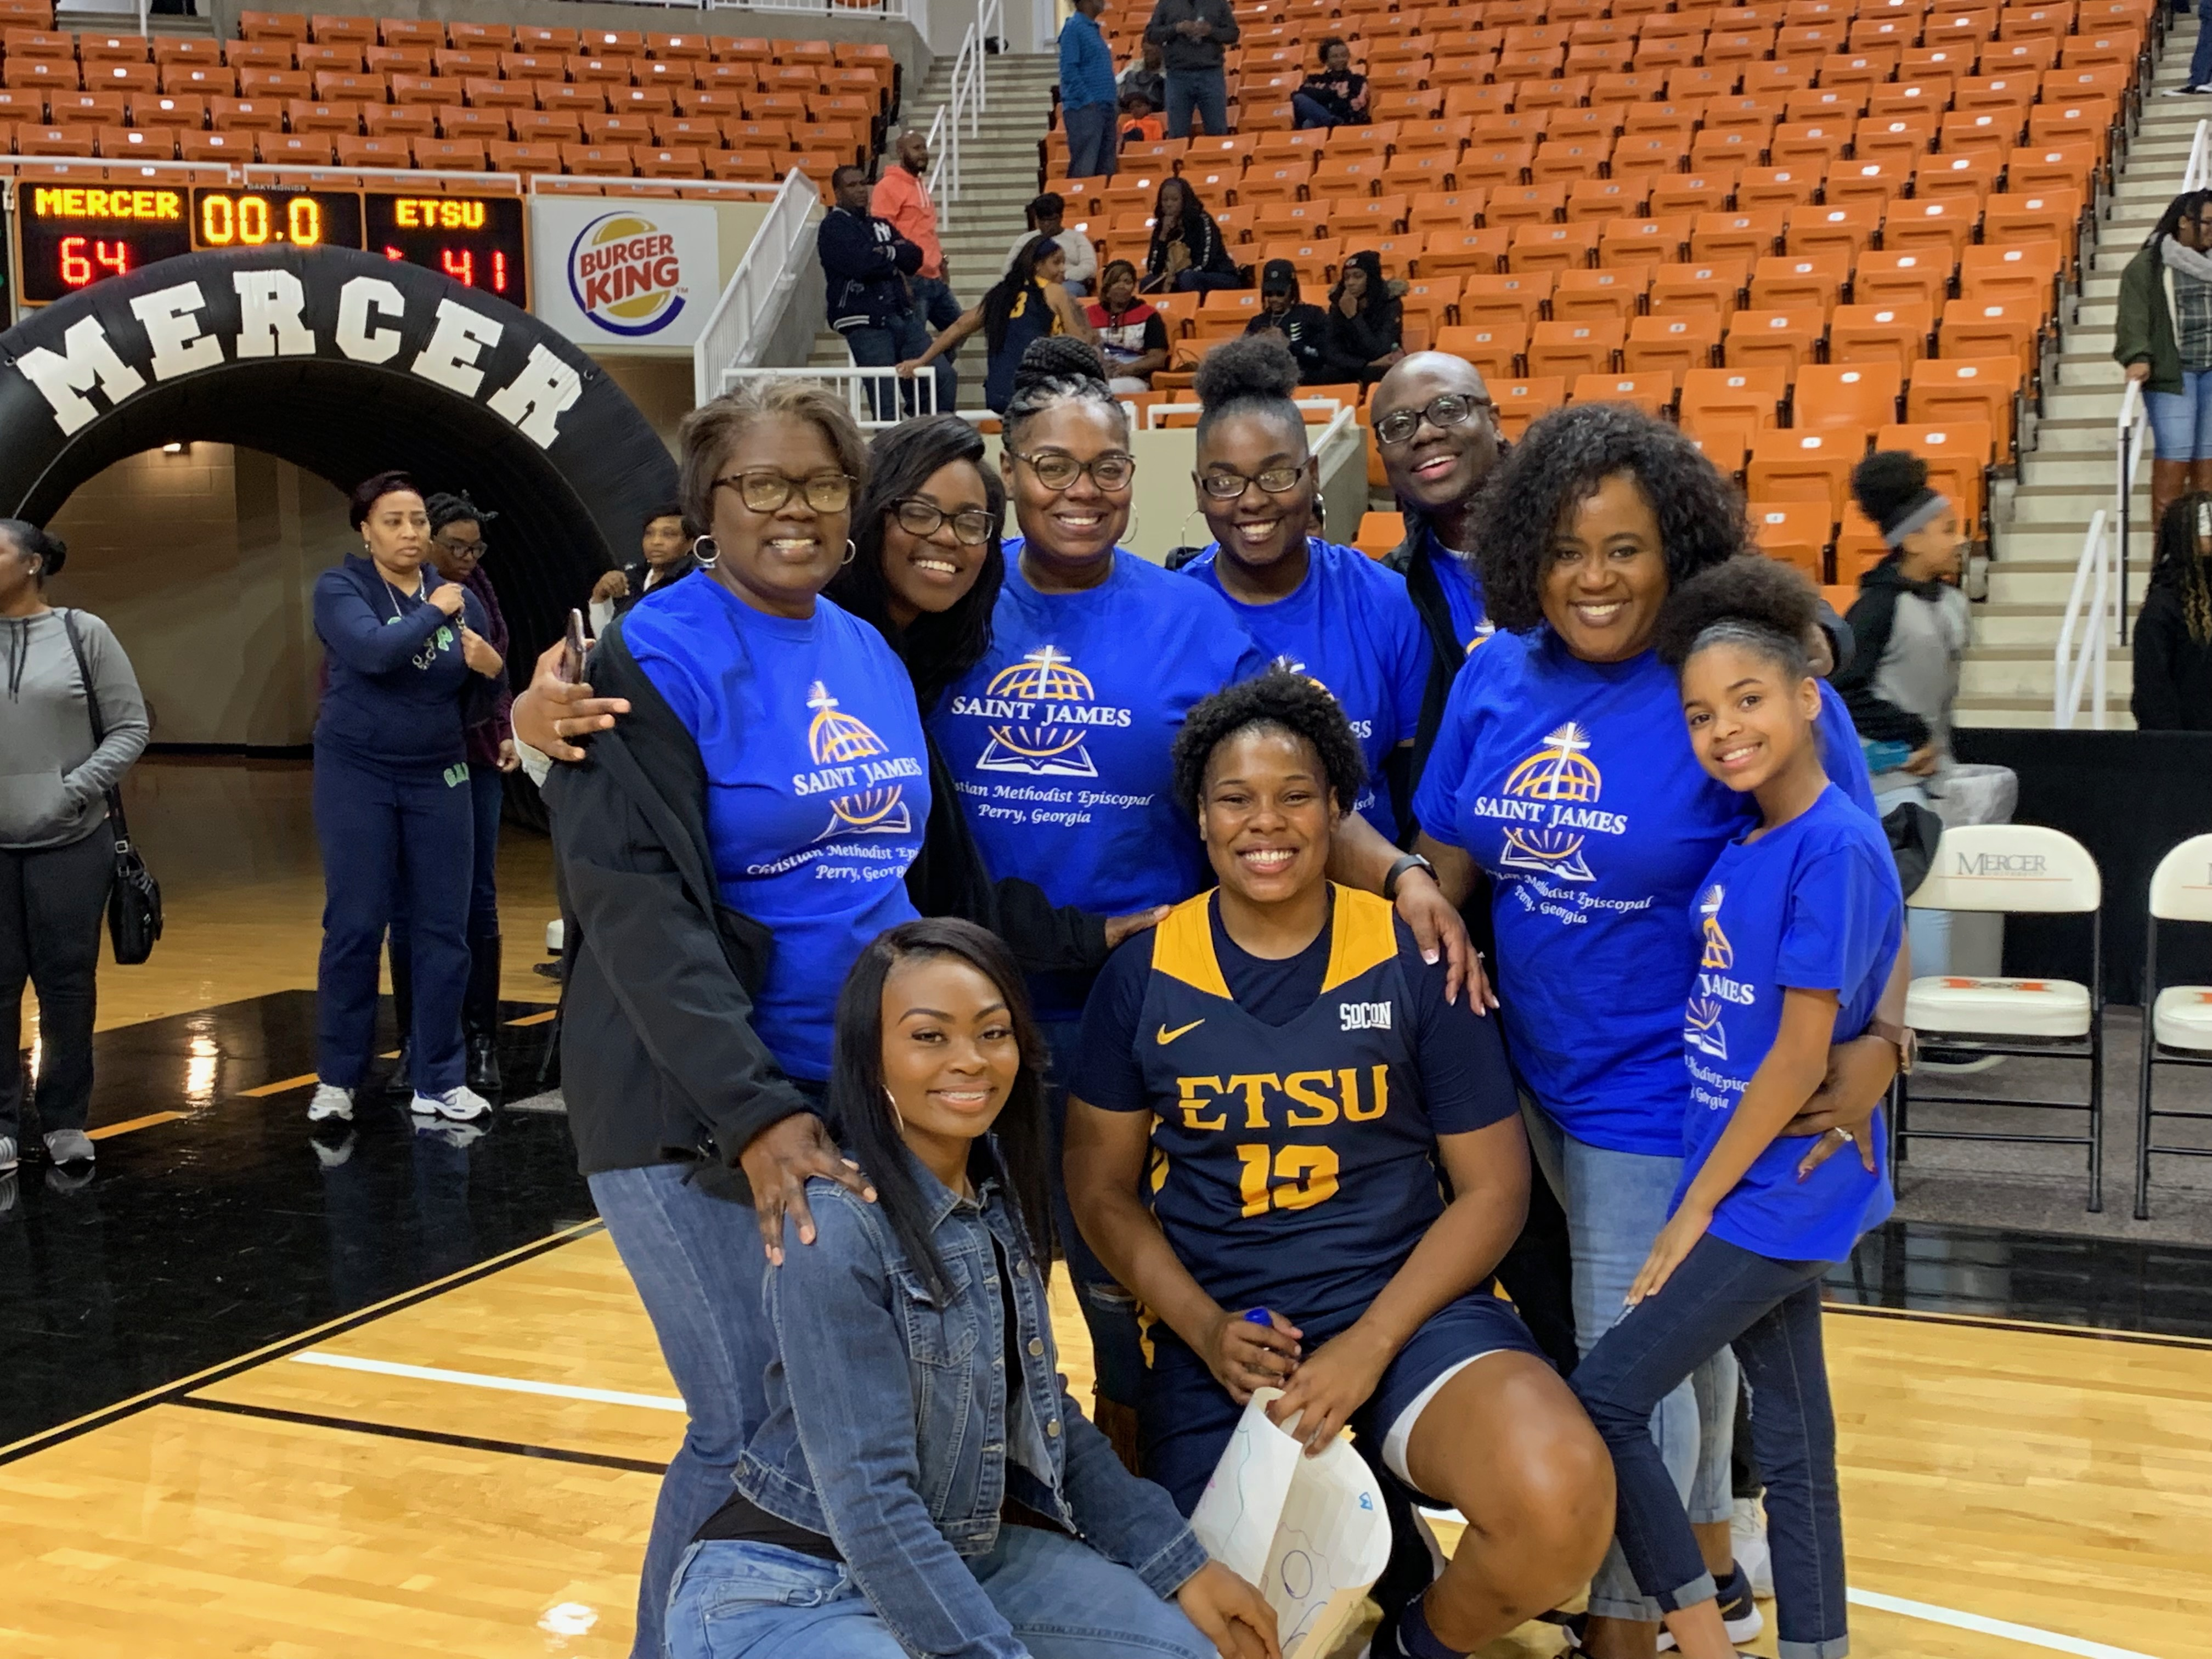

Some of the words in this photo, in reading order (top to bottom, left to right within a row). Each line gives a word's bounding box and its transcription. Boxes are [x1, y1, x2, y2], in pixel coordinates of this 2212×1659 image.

[35, 188, 179, 219] MERCER
[202, 195, 320, 246] 00.0
[396, 200, 484, 228] ETSU
[59, 237, 127, 286] 64
[442, 250, 505, 291] 41
[580, 234, 674, 278] BURGER
[586, 256, 679, 311] KING
[16, 269, 583, 450] MERCER
[951, 696, 1035, 719] SAINT
[1041, 704, 1131, 727] JAMES
[792, 766, 857, 795] SAINT
[860, 757, 922, 788] JAMES
[992, 785, 1074, 803] Methodist
[1077, 791, 1155, 809] Episcopal
[978, 804, 1026, 824] Perry,
[1031, 809, 1091, 827] Georgia
[1474, 797, 1545, 822] SAINT
[1548, 805, 1628, 834] JAMES
[826, 843, 893, 860] Methodist
[815, 865, 860, 883] Perry,
[1540, 902, 1588, 925] Georgia
[1577, 891, 1654, 913] Episcopal
[1176, 1064, 1389, 1131] ETSU
